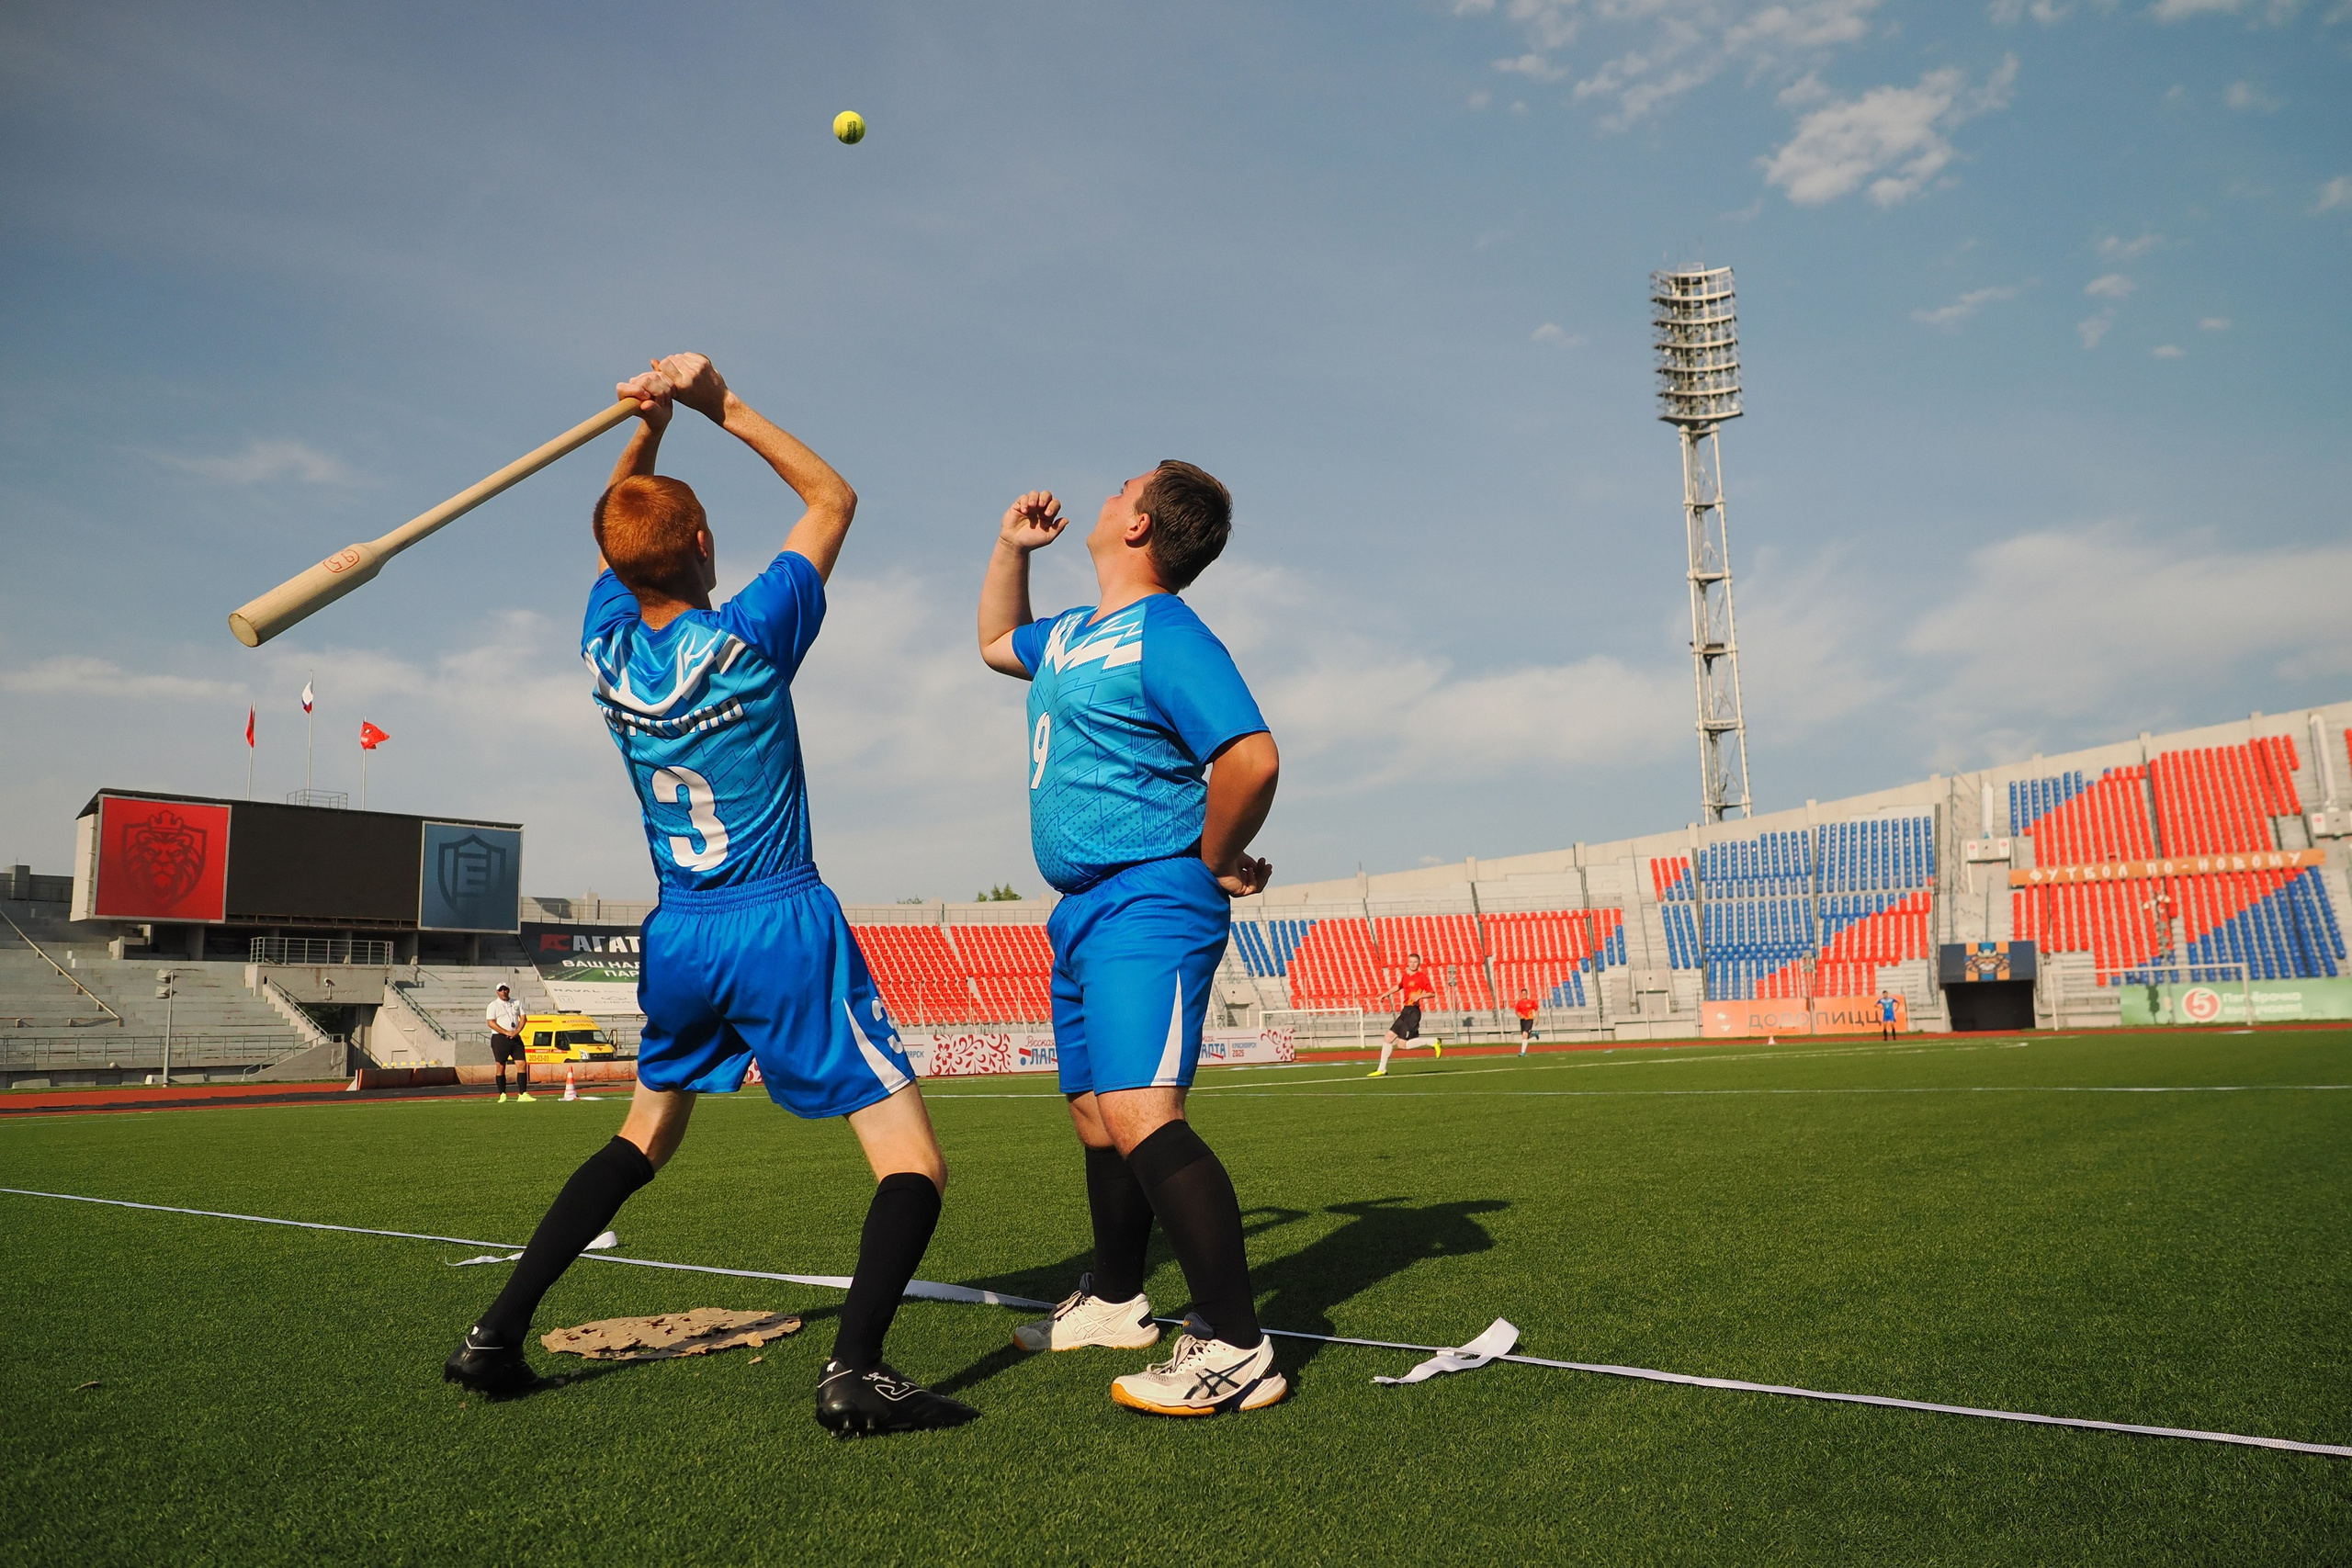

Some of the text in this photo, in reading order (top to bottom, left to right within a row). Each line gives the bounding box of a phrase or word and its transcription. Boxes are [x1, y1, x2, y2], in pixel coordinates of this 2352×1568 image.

[1030, 711, 1051, 790] 9
[651, 765, 729, 872] 3
[2030, 864, 2129, 883] ФУТБОЛ
[561, 959, 605, 968] ВАШ
[871, 997, 904, 1055] 3
[1815, 1010, 1883, 1027] ПИЦЦ
[905, 1050, 924, 1058] ОЯРСК
[1029, 1048, 1057, 1065] ЛАП
[1199, 1043, 1227, 1059] АПТА
